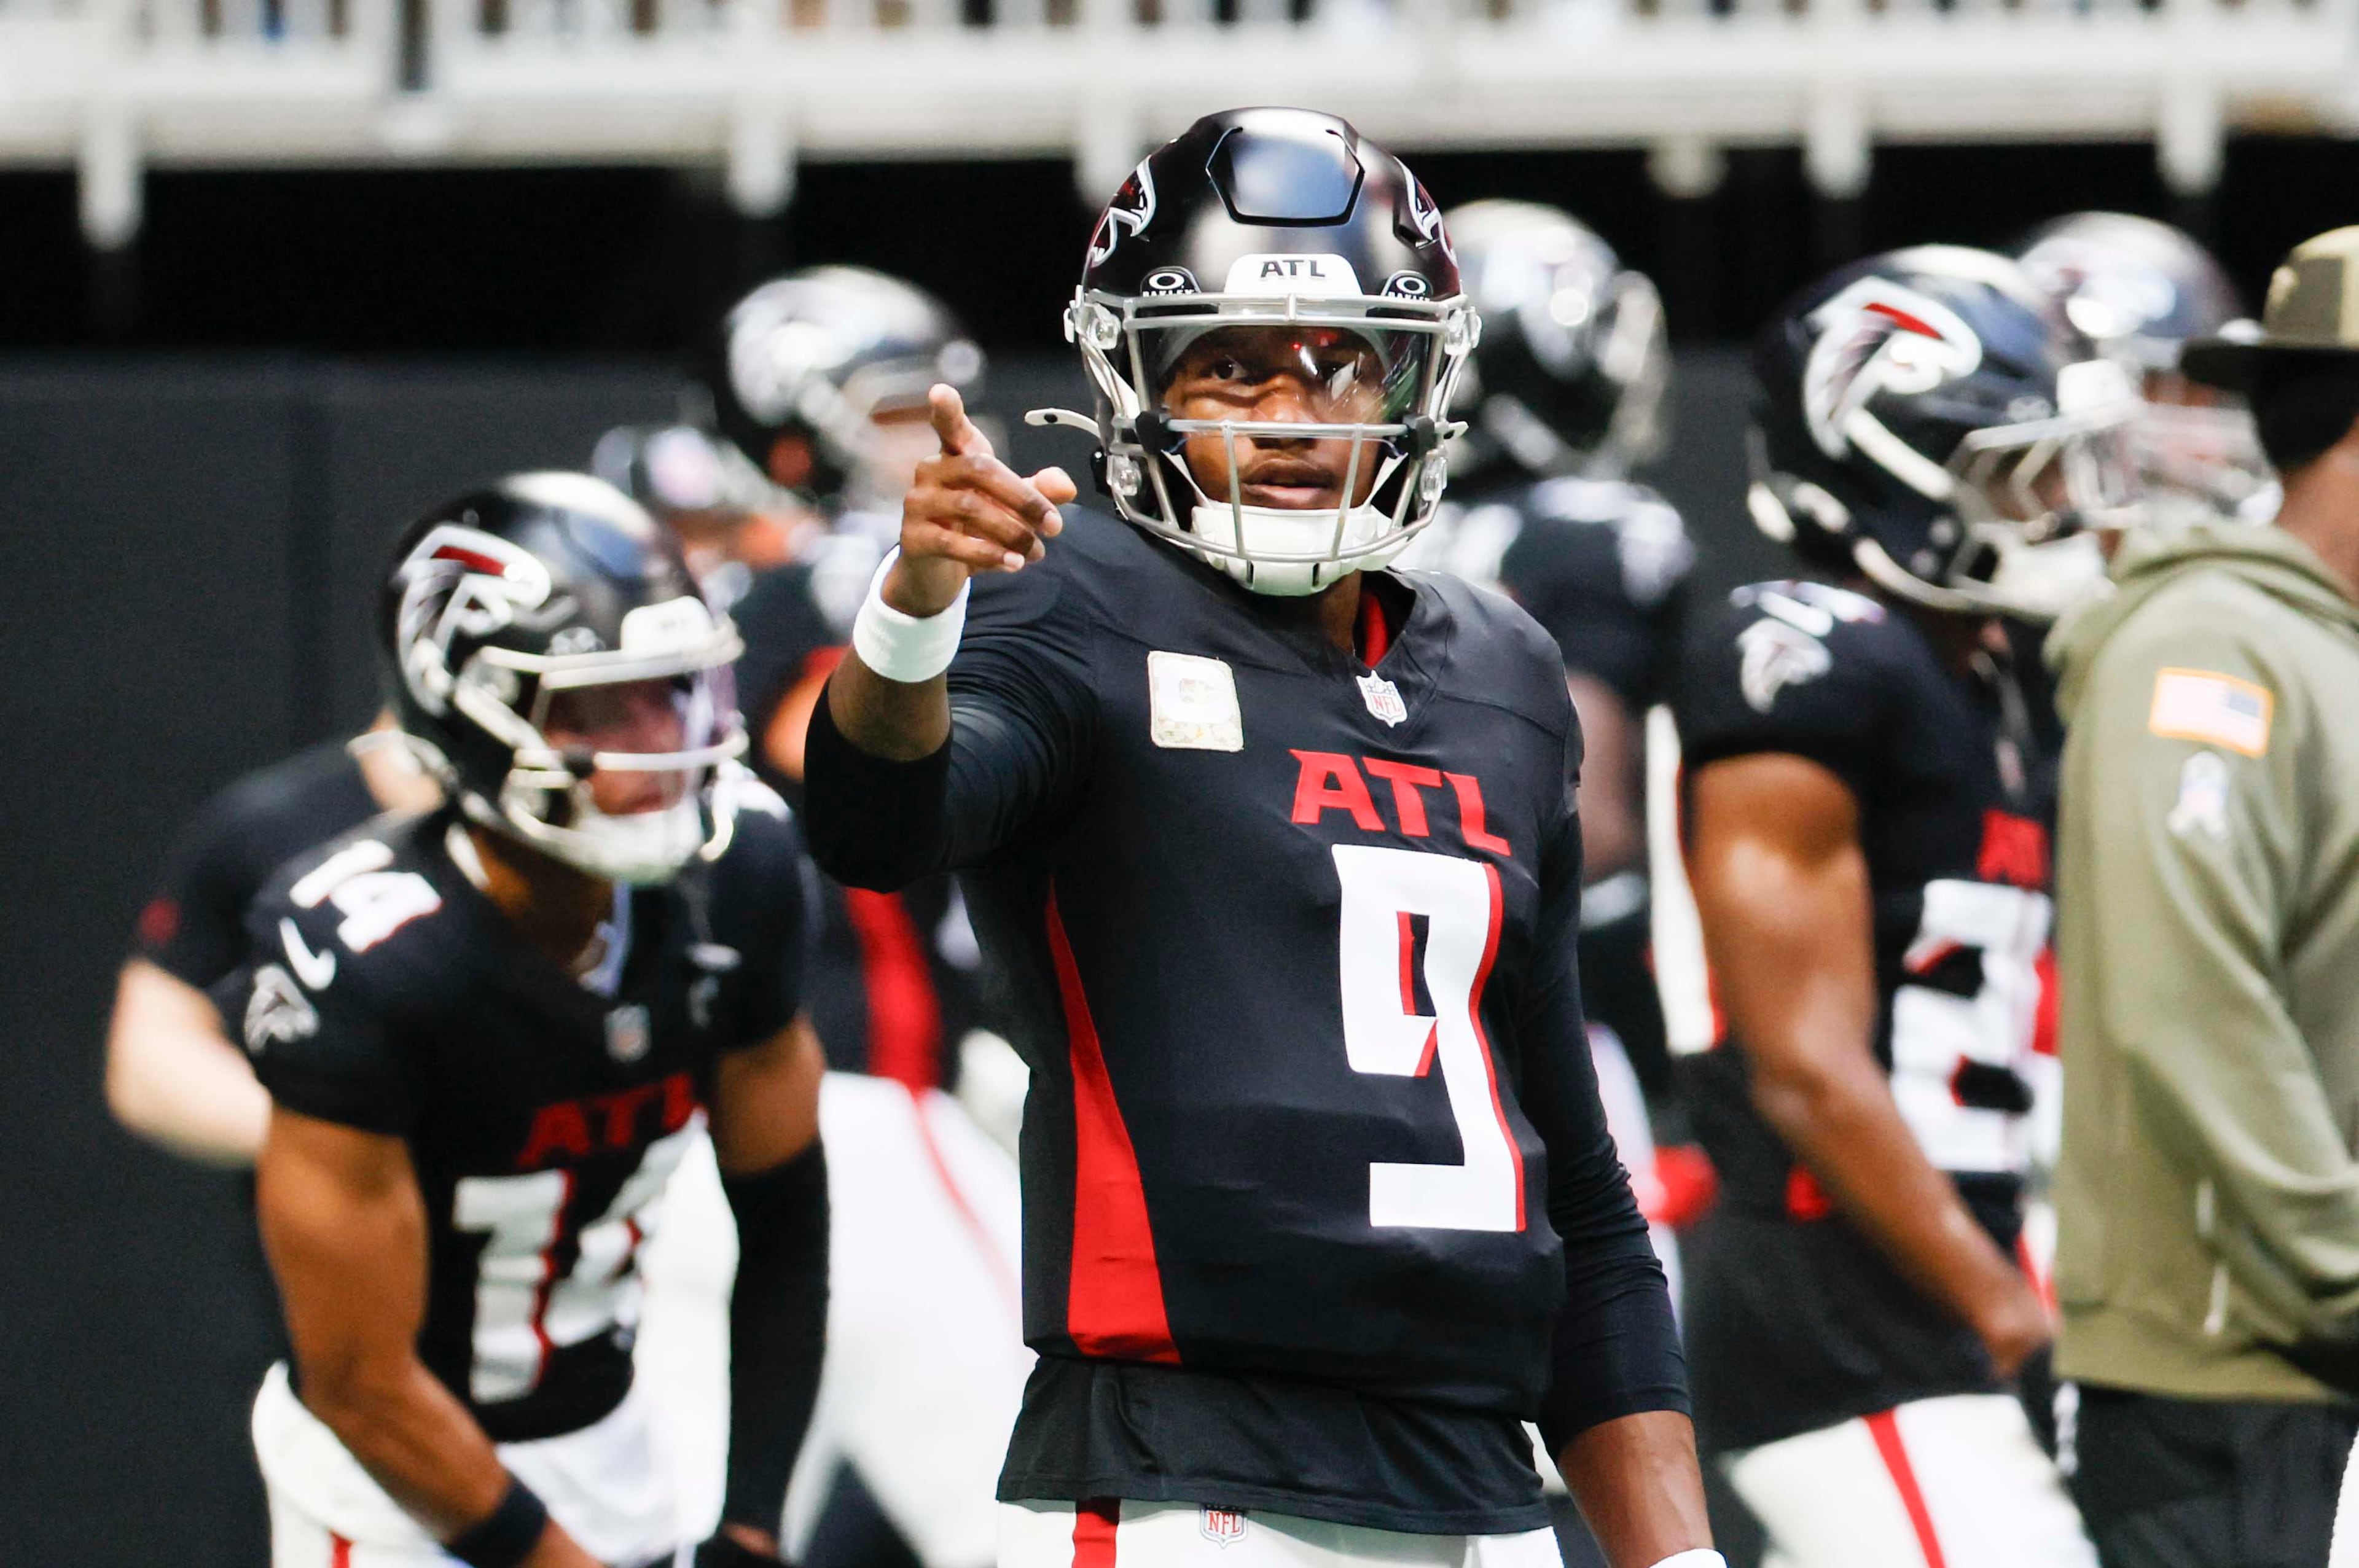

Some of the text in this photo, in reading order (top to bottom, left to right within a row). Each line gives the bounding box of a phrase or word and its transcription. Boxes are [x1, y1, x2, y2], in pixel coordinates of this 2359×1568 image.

[1261, 259, 1326, 278] ATL
[1371, 694, 1401, 714] NFL
[1289, 749, 1511, 857] ATL
[1331, 844, 1526, 1232] 9
[1208, 1511, 1241, 1535] NFL
